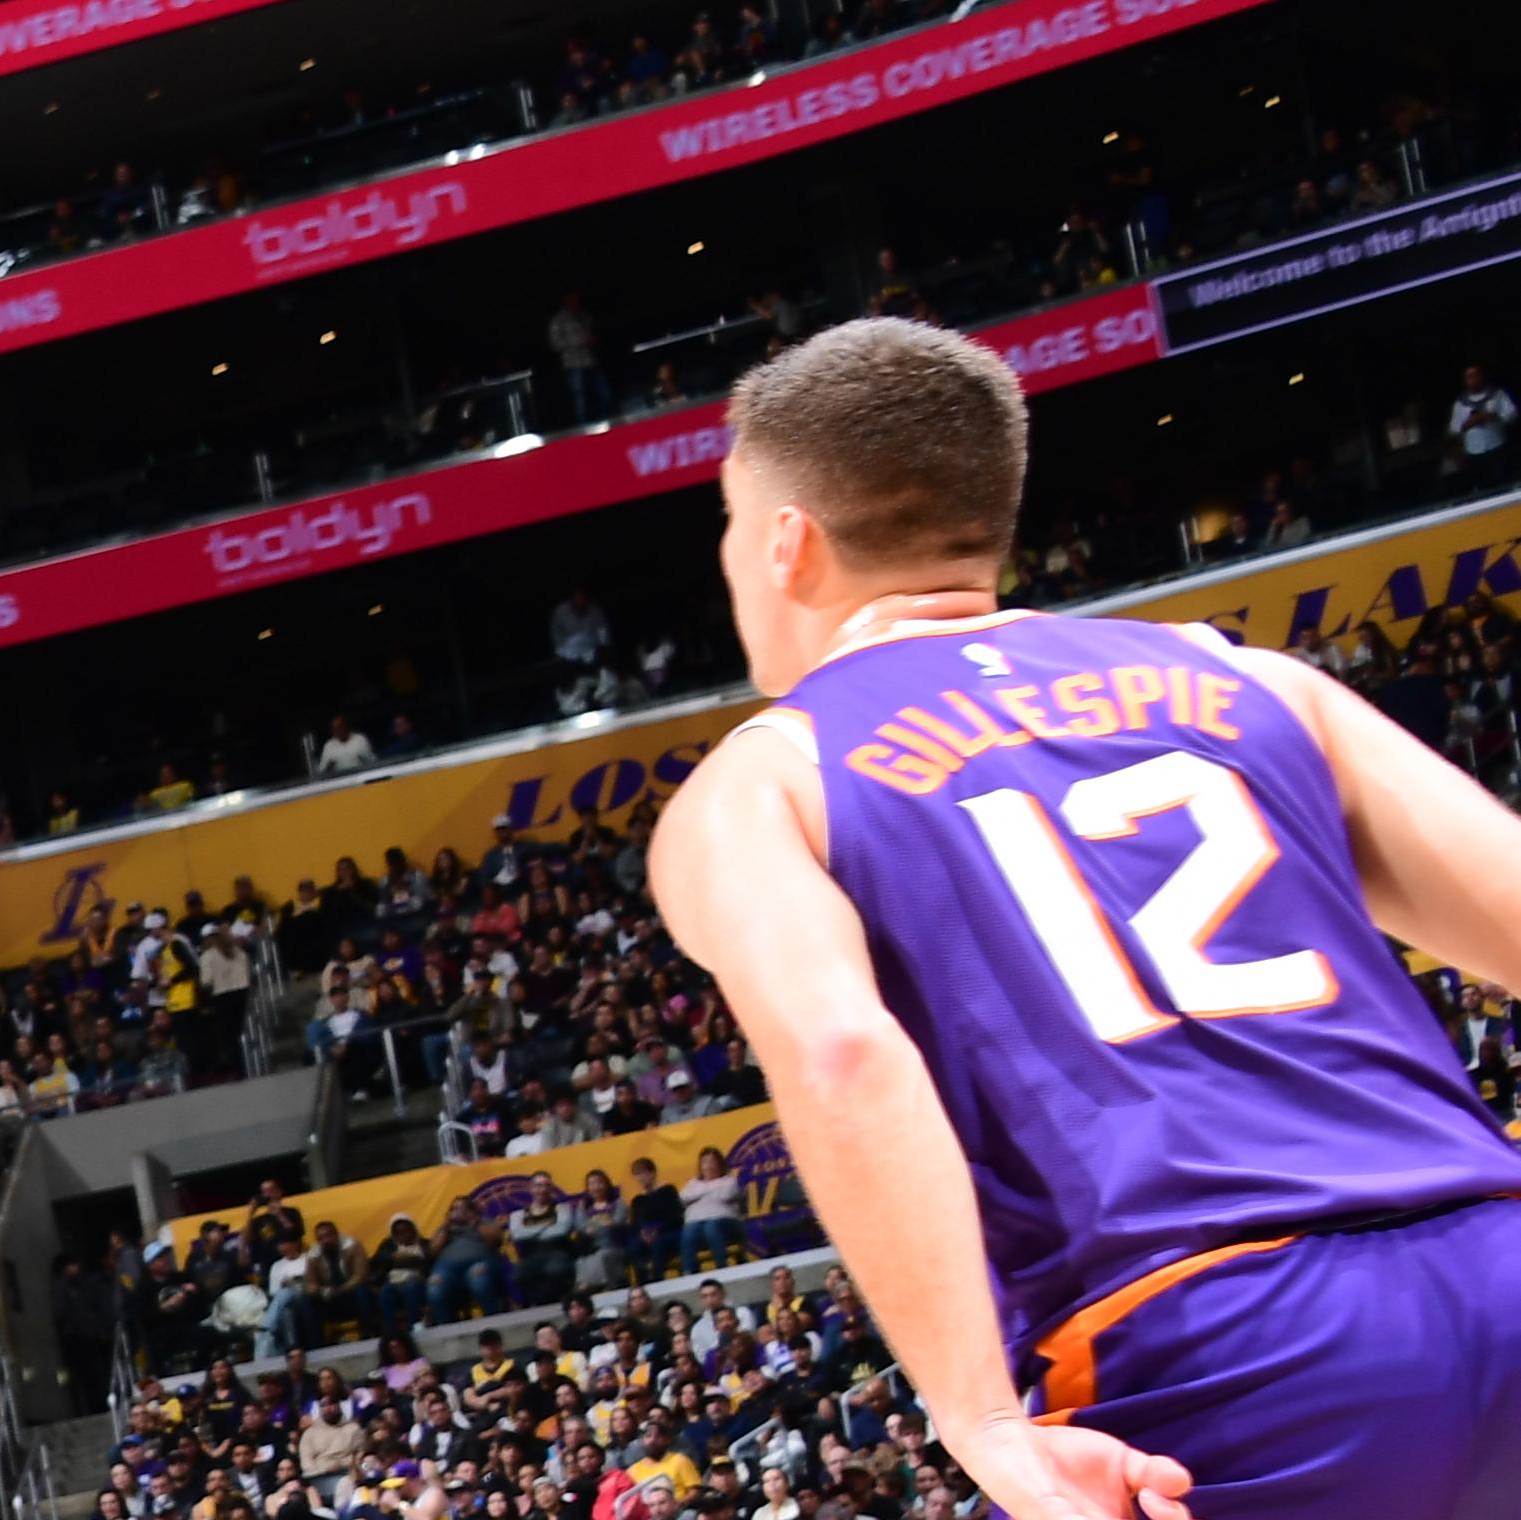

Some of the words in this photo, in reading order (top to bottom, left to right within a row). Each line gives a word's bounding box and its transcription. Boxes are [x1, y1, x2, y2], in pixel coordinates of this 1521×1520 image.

[658, 74, 880, 162] WIRELESS
[881, 0, 1111, 97] COVERAGE
[245, 181, 466, 268] boldyn
[1188, 260, 1326, 308] Welcome
[1362, 228, 1416, 258] the
[205, 491, 431, 580] boldyn
[845, 664, 1243, 797] GILLESPIE
[955, 750, 1343, 1046] 12
